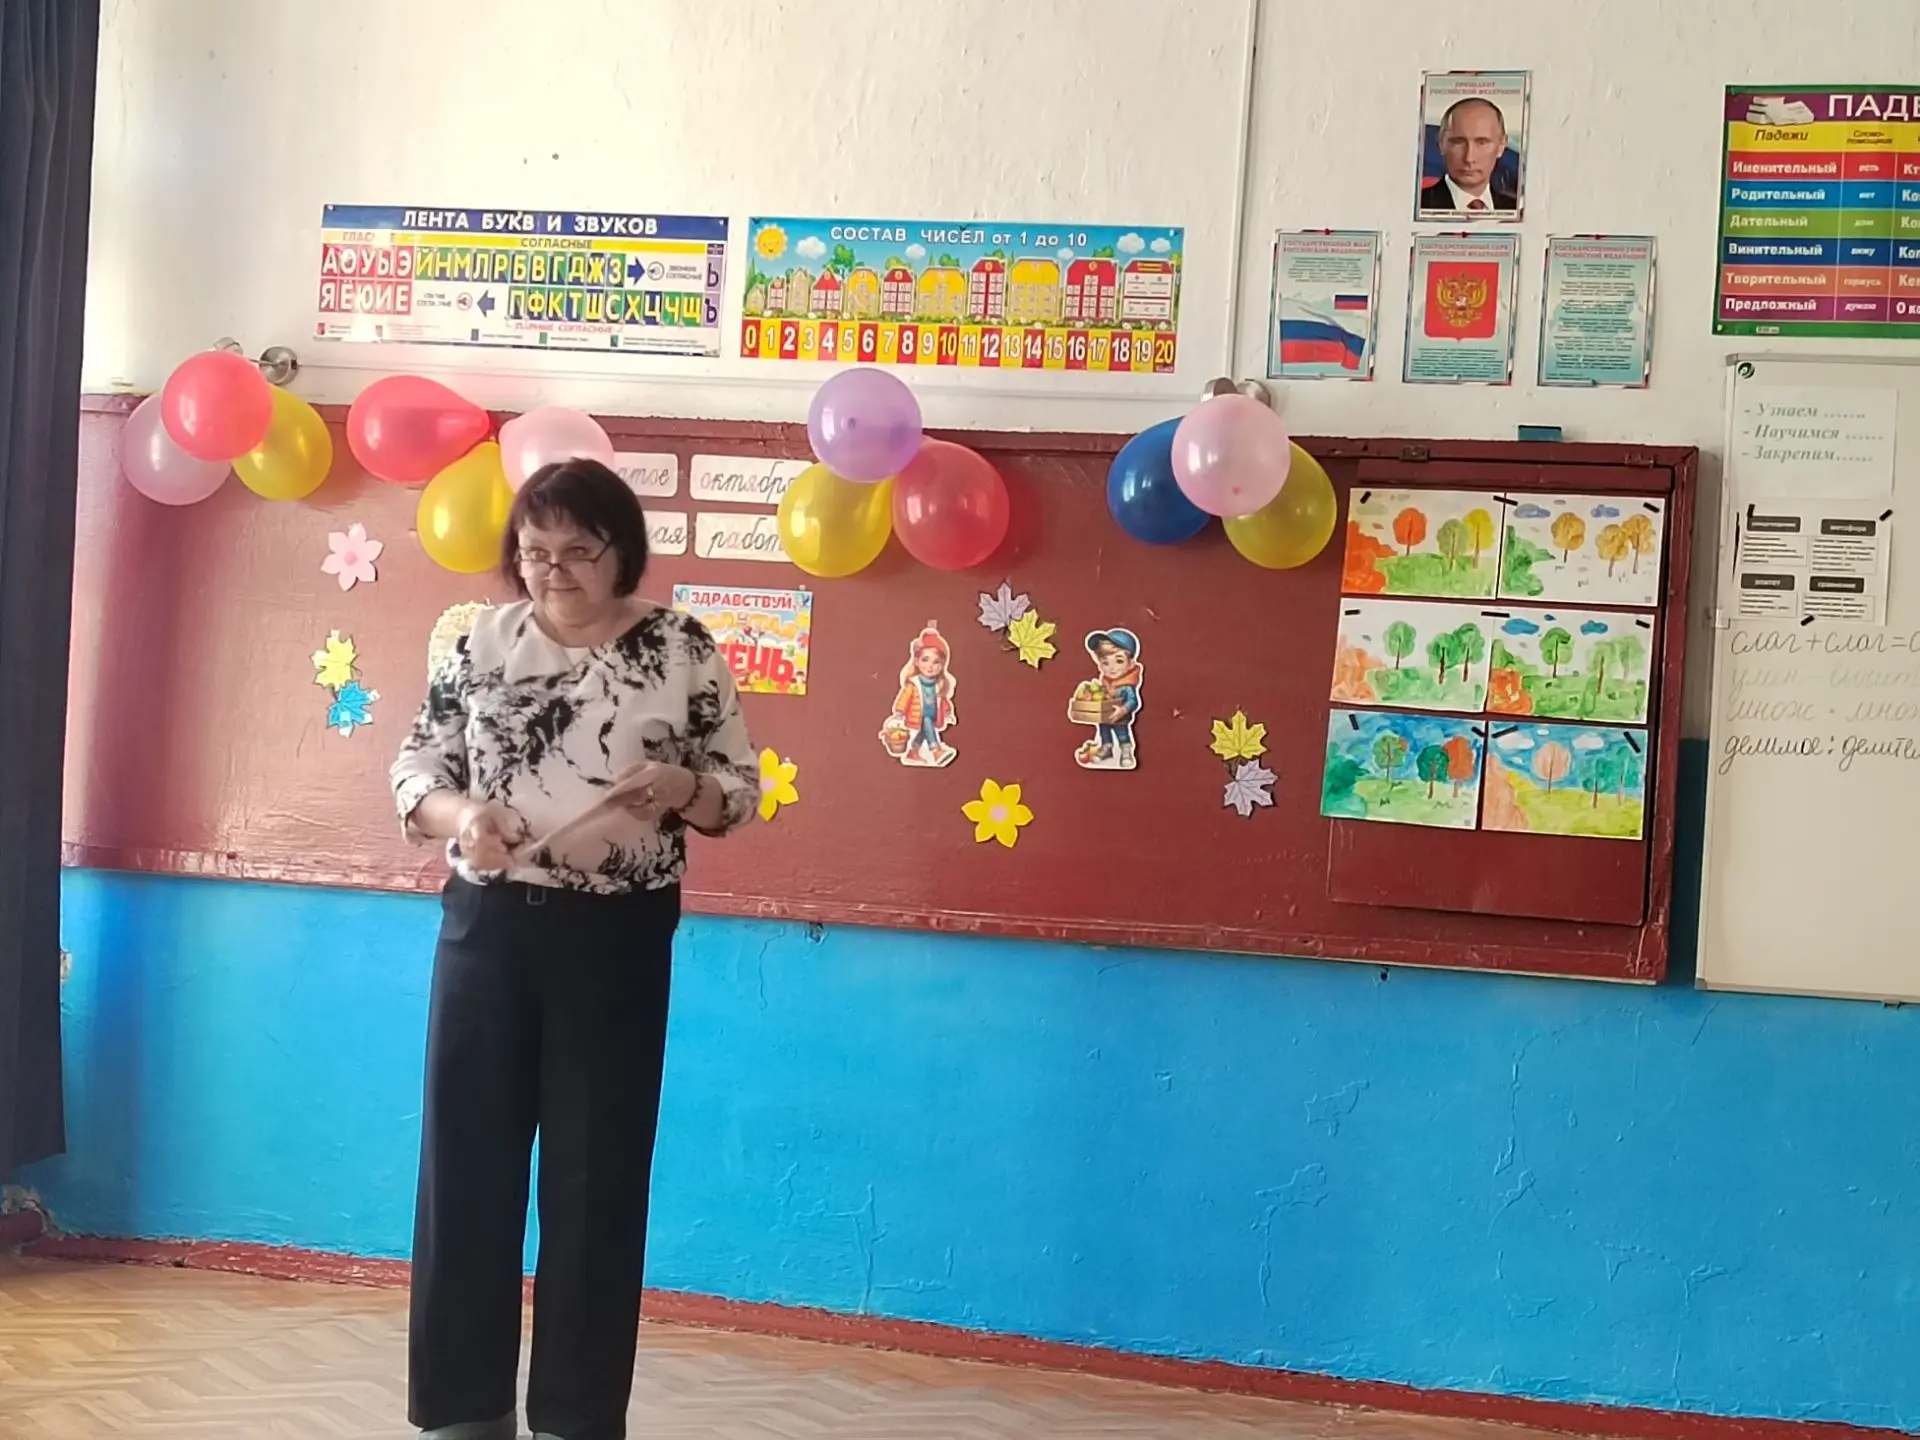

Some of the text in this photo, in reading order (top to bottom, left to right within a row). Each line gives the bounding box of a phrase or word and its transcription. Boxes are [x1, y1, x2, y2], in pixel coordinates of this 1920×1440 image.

[1754, 129, 1809, 142] Падежи
[1733, 161, 1837, 174] Именительный
[1731, 187, 1825, 200] Родительный
[403, 210, 658, 235] ЛЕНТА БУКВ И ЗВУКОВ
[1729, 215, 1808, 228] Дательный
[521, 238, 593, 249] СОГЛАСНЫЕ
[830, 226, 1087, 247] СОСТАВ ЧИСЕЛ от 1 до 10
[1728, 243, 1823, 256] Винительный
[1725, 272, 1827, 287] Творительный
[1725, 297, 1817, 312] Предложный
[745, 325, 1174, 364] 0 1 2 3 4 5 6 7 8 9 10 11 12 13 14 15 16 17 18 19 20
[1756, 403, 1819, 417] Узнаем
[1754, 424, 1840, 441] Научимся
[700, 461, 794, 502] октябр
[706, 517, 782, 557] работ
[691, 591, 797, 610] ЗДРАВСТВУЙ,
[1718, 735, 1822, 775] делимое
